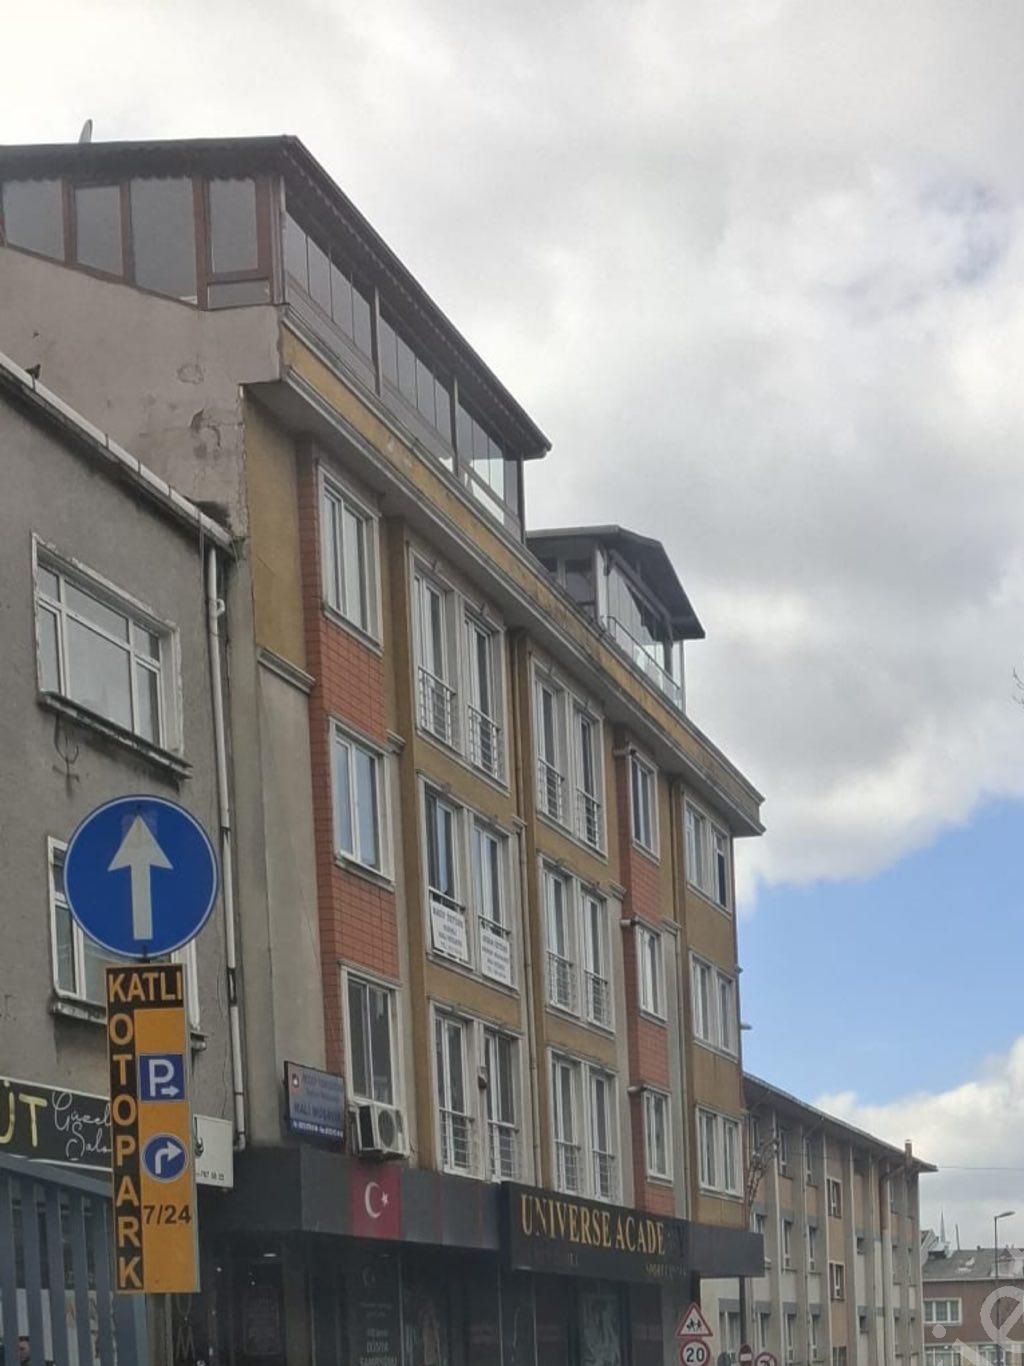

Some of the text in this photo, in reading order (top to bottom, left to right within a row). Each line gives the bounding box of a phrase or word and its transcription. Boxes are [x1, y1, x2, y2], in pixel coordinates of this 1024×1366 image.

[108, 970, 183, 1003] KATLI
[108, 1012, 144, 1289] OTOPARK
[143, 1204, 192, 1225] 7/24
[520, 1193, 612, 1249] UNIVERSE
[686, 1347, 705, 1363] 20
